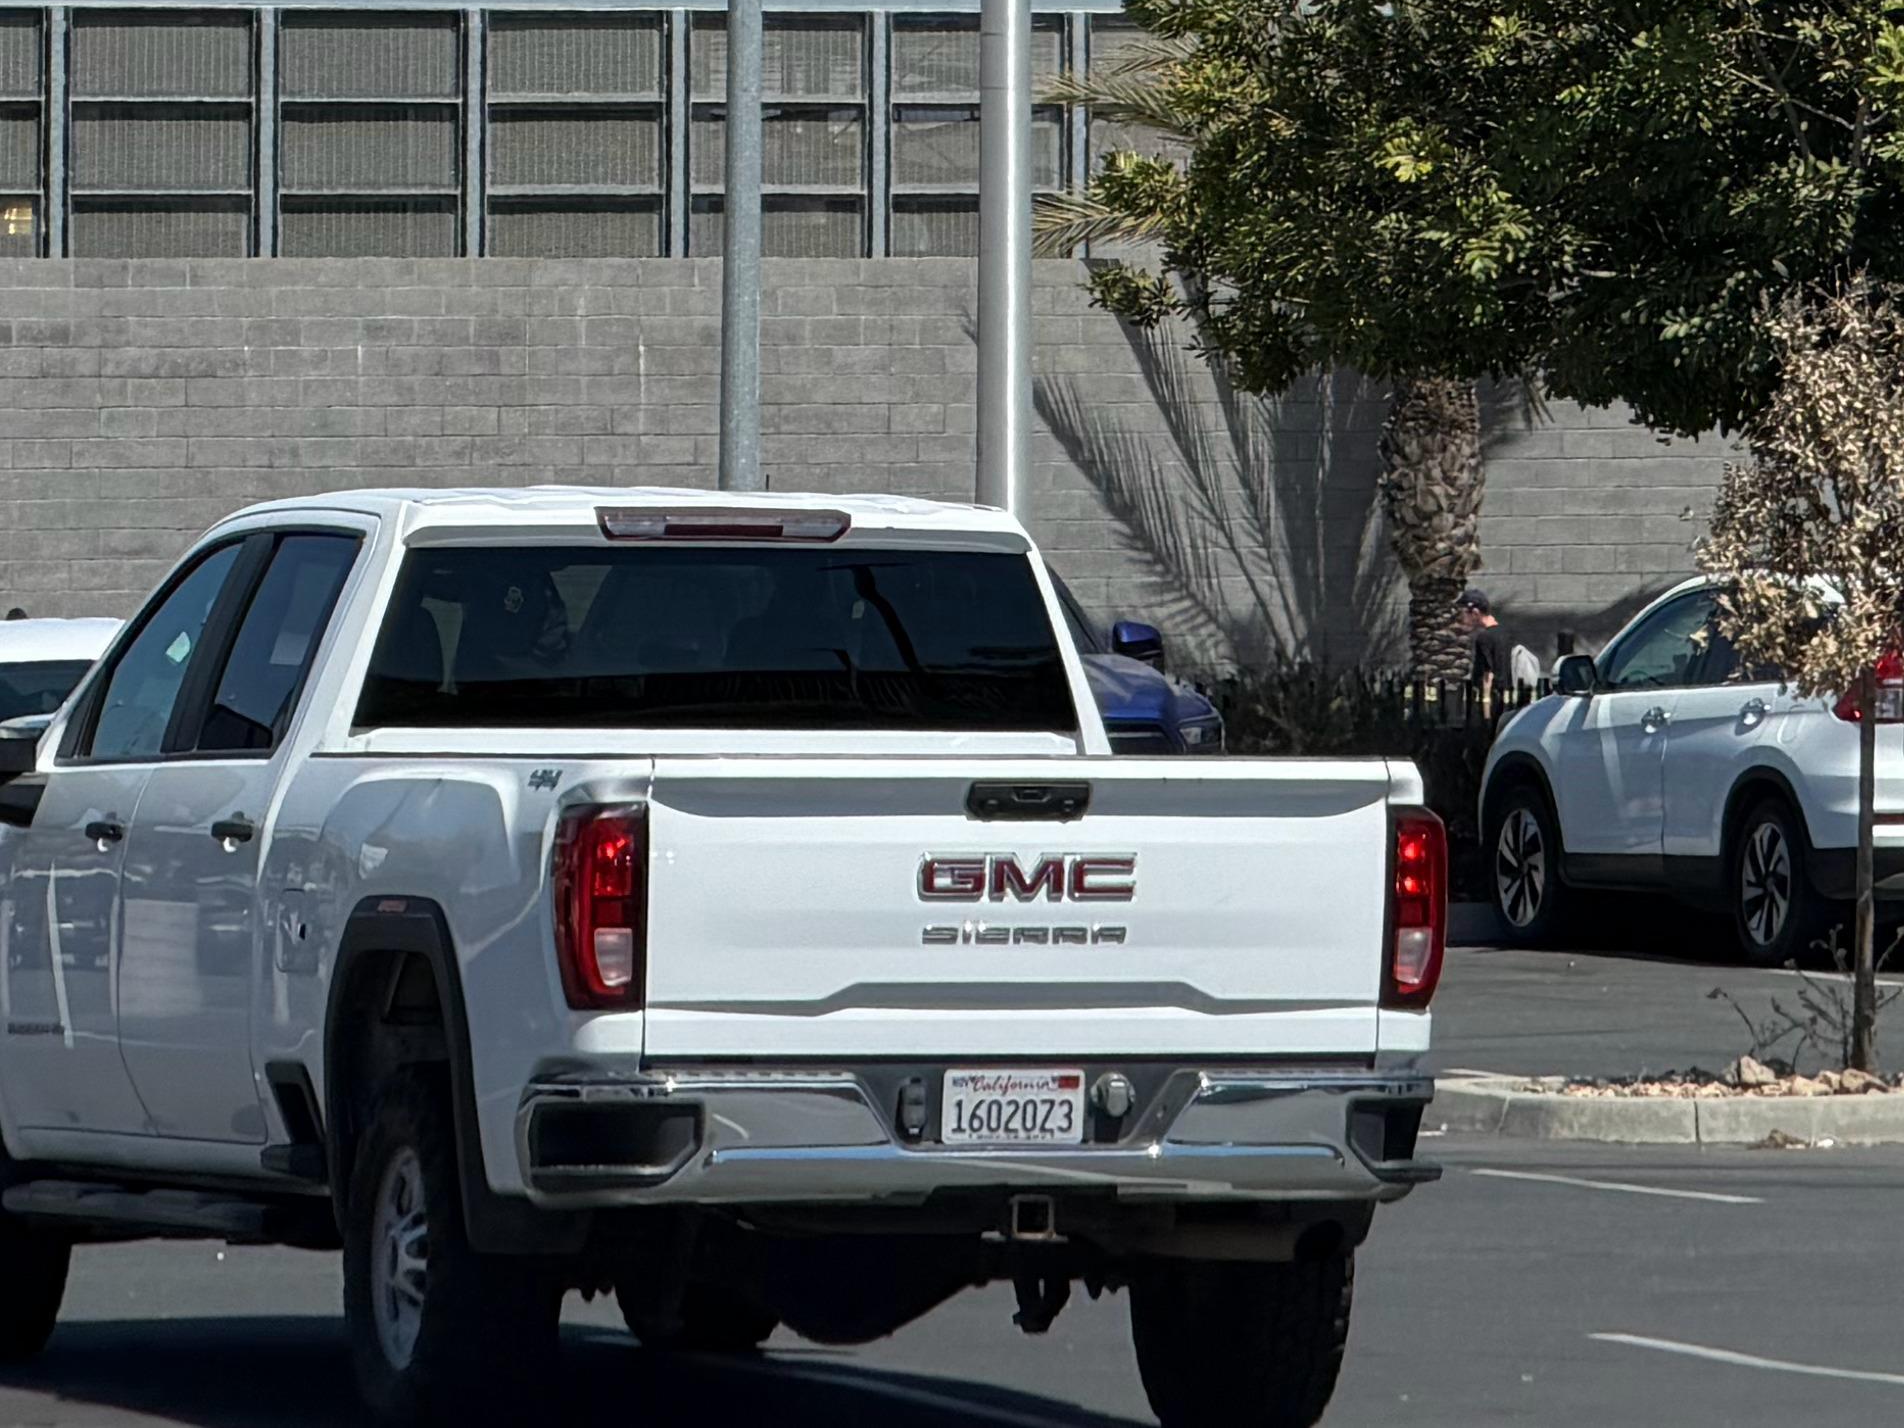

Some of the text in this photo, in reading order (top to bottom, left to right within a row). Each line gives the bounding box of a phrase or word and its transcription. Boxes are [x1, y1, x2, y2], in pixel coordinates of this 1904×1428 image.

[916, 851, 1138, 903] GMC
[921, 923, 1127, 945] SIERRA
[972, 1074, 1051, 1096] California
